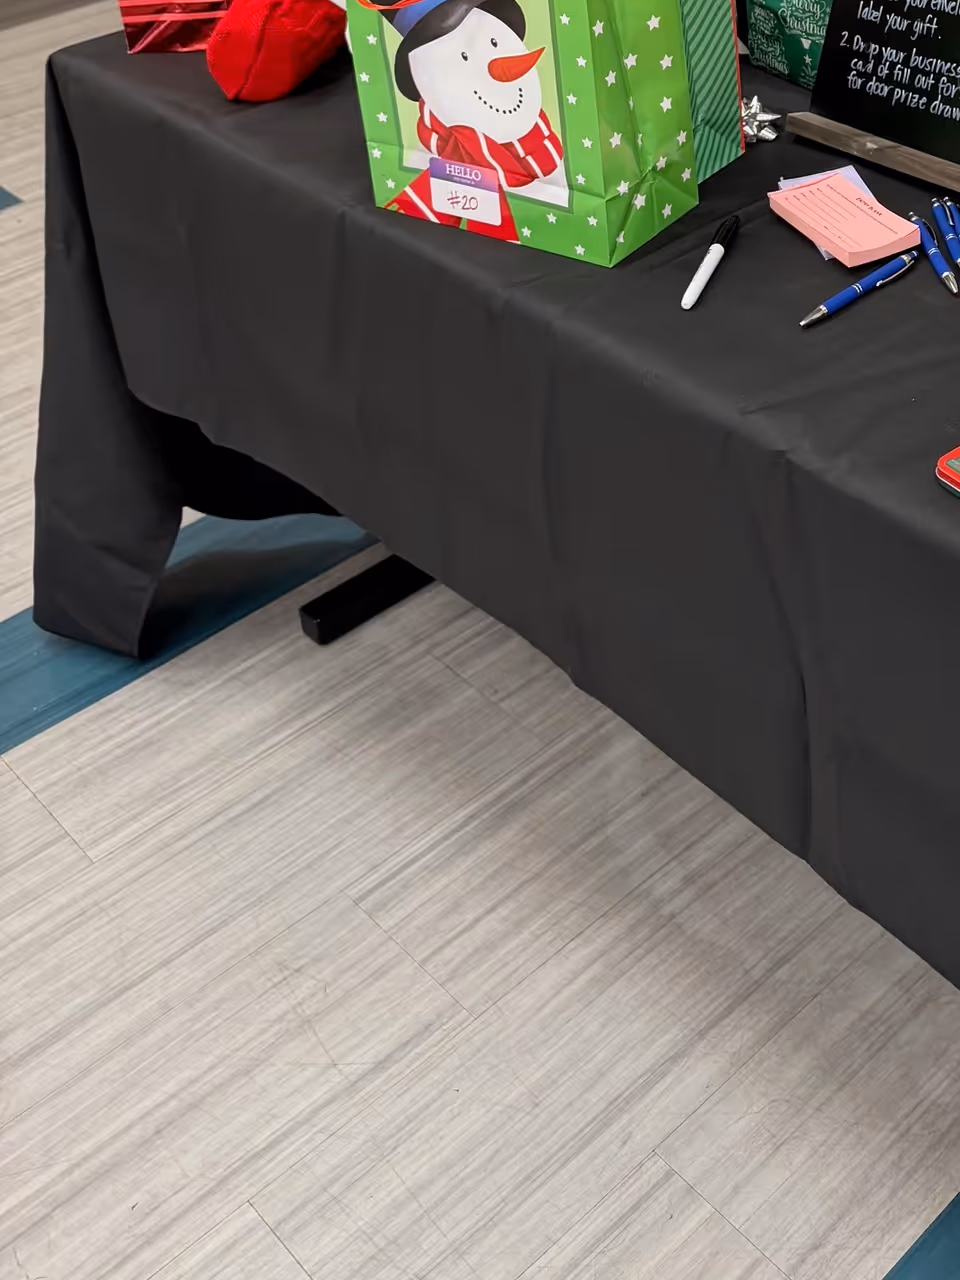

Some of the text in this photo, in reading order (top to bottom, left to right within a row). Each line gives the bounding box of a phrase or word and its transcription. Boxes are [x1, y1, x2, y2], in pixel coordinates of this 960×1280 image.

[857, 0, 884, 24] label
[884, 12, 912, 34] your
[839, 31, 850, 48] 2.
[882, 46, 908, 64] your
[847, 71, 866, 90] for
[866, 76, 894, 97] door
[892, 88, 928, 107] prize
[893, 64, 911, 85] fill
[914, 73, 936, 92] out
[445, 163, 482, 182] HELLO
[447, 190, 479, 211] #20
